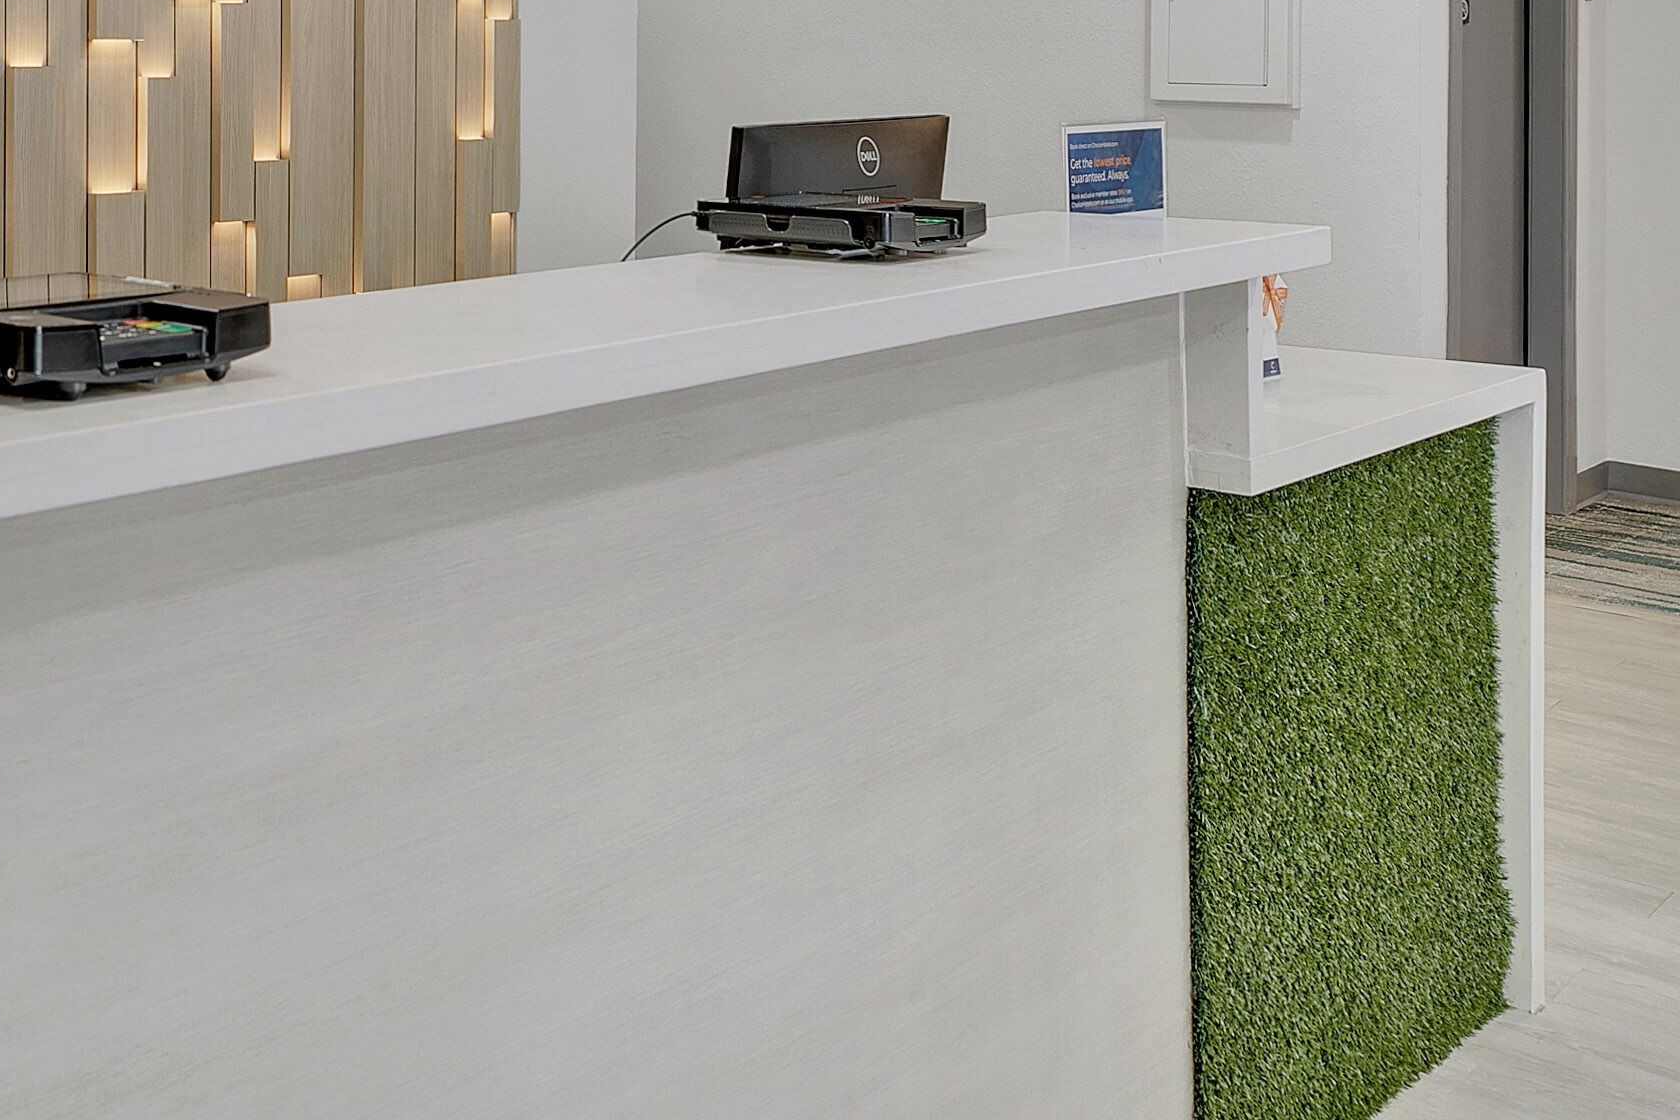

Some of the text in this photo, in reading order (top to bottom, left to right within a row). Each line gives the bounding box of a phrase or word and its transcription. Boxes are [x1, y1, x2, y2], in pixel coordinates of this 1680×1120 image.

[860, 151, 878, 162] DELL
[1070, 155, 1132, 170] Get the lowest price
